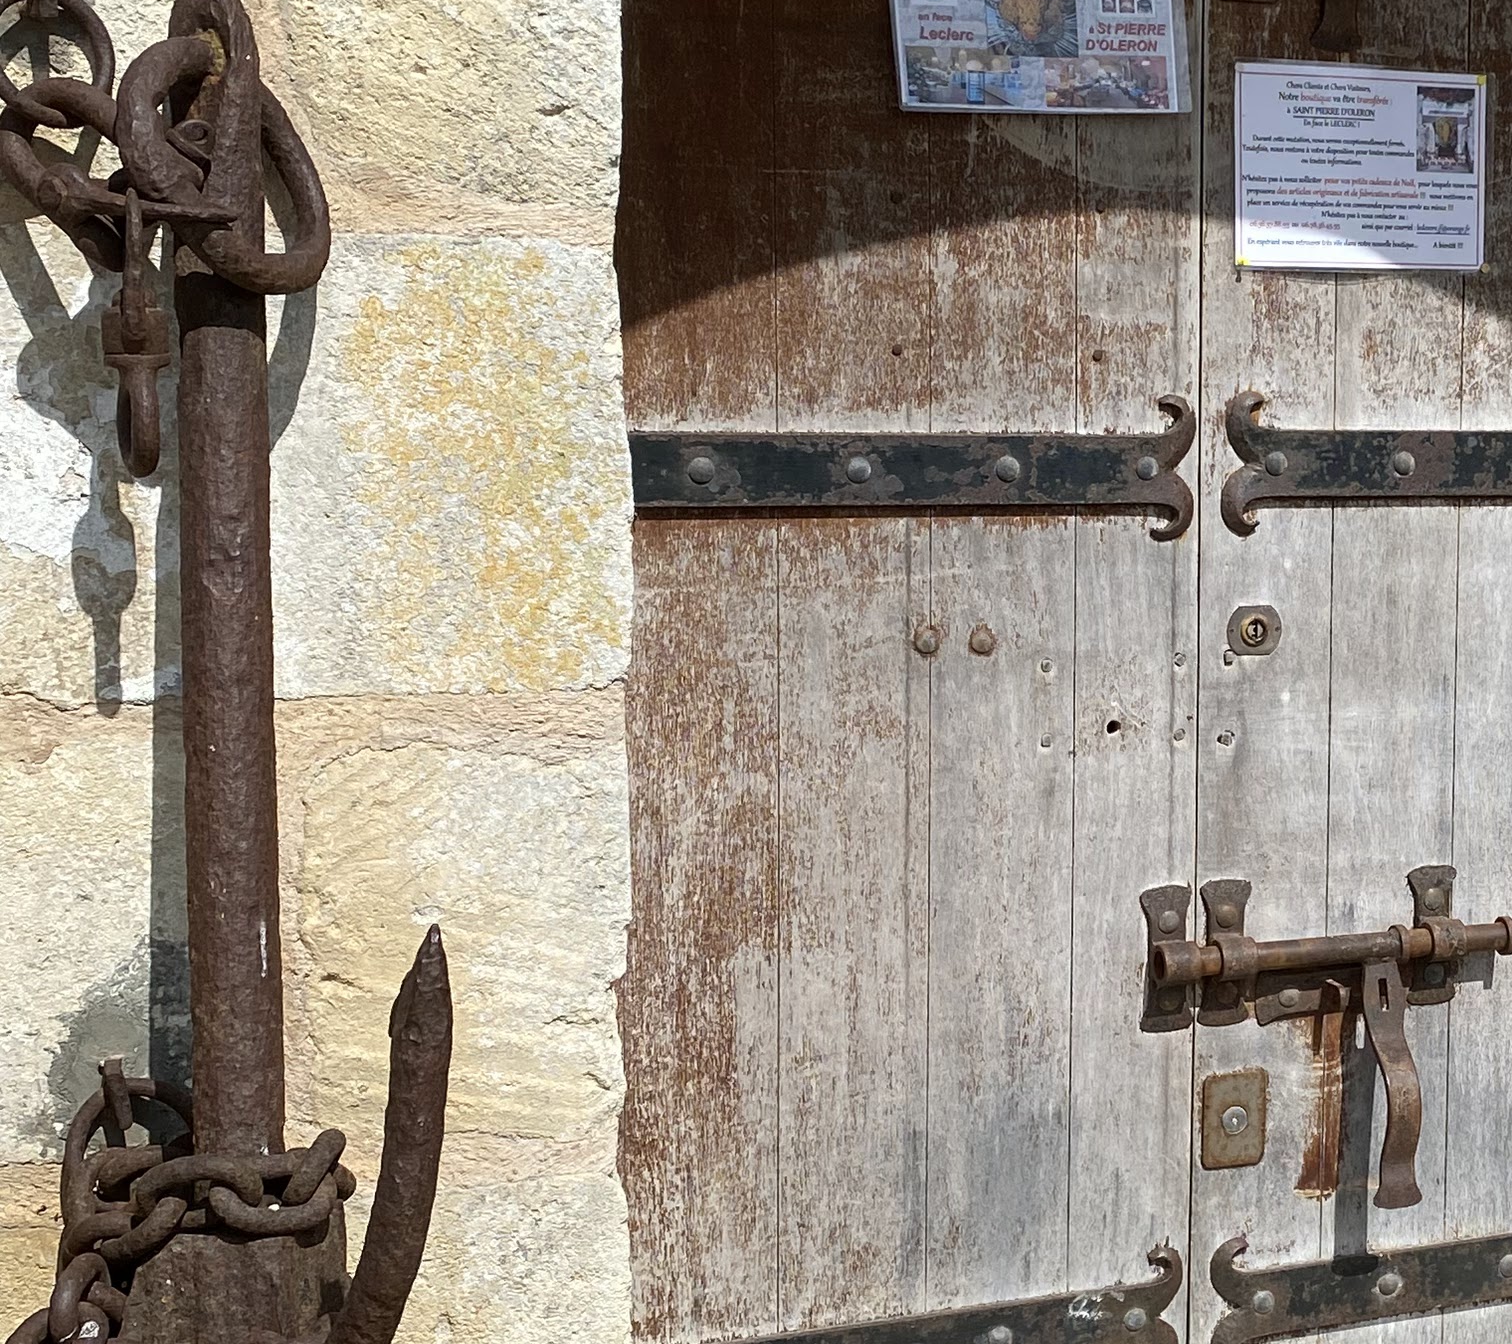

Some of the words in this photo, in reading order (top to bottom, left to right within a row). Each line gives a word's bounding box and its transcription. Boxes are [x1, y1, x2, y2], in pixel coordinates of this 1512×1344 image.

[932, 12, 953, 22] face
[919, 26, 974, 41] Leclerc
[1097, 22, 1111, 35] St
[1114, 23, 1166, 36] PIERRE
[1085, 39, 1158, 52] D'OLERON
[1303, 82, 1323, 90] Clients
[1278, 91, 1299, 101] Notre
[1300, 92, 1330, 104] boutique
[1342, 95, 1355, 104] être
[1293, 106, 1314, 115] SAINT
[1315, 107, 1340, 115] PIERRE
[1341, 107, 1375, 117] D'OLERON
[1311, 119, 1323, 128] face
[1330, 120, 1357, 128] LECLERC
[1325, 146, 1354, 155] disposition
[1324, 177, 1339, 186] pour
[1351, 178, 1368, 187] petits
[1393, 177, 1400, 186] de
[1276, 186, 1287, 195] des
[1289, 187, 1312, 196] articles
[1312, 189, 1342, 198] originaux
[1350, 189, 1358, 197] de
[1358, 188, 1389, 199] fabrication
[1291, 199, 1299, 207] de
[1335, 199, 1342, 207] de
